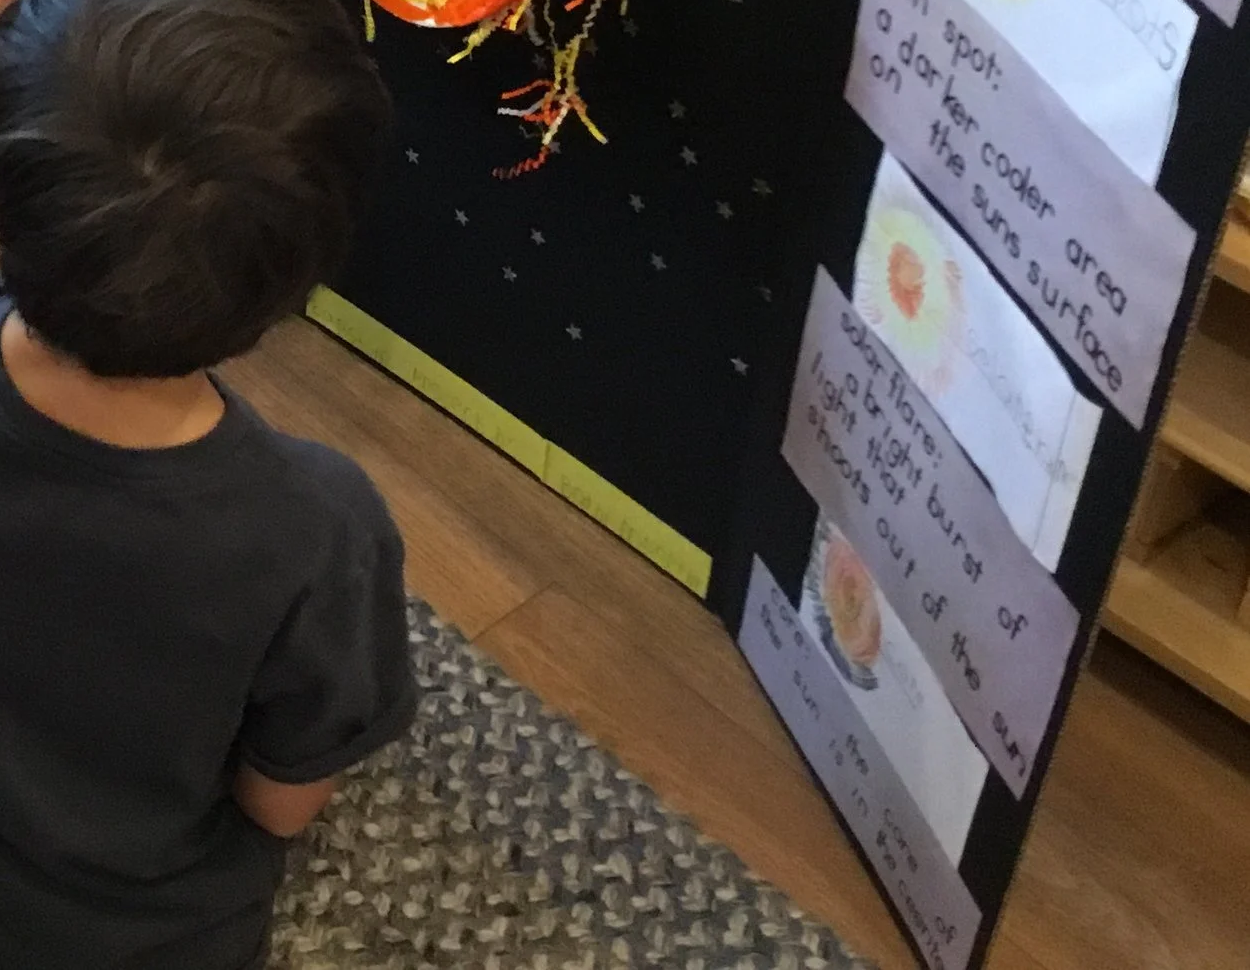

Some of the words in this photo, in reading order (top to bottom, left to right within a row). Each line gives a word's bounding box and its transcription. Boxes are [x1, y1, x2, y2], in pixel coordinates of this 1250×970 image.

[876, 7, 892, 33] a
[898, 31, 979, 134] darker
[980, 140, 1056, 221] cooler
[1064, 236, 1127, 317] area
[943, 18, 1003, 92] spot:
[870, 53, 902, 94] on
[928, 119, 967, 178] the
[971, 182, 1021, 260] suns
[1026, 259, 1124, 393] surface
[809, 350, 857, 431] light
[866, 435, 906, 505] that
[840, 310, 883, 377] solar
[887, 372, 942, 469] flare:
[863, 382, 923, 490] bright
[927, 483, 984, 583] burst
[997, 603, 1028, 640] of
[808, 404, 871, 505] shoots
[875, 516, 916, 579] out
[921, 589, 948, 623] of
[950, 631, 980, 693] the
[991, 709, 1026, 778] sun
